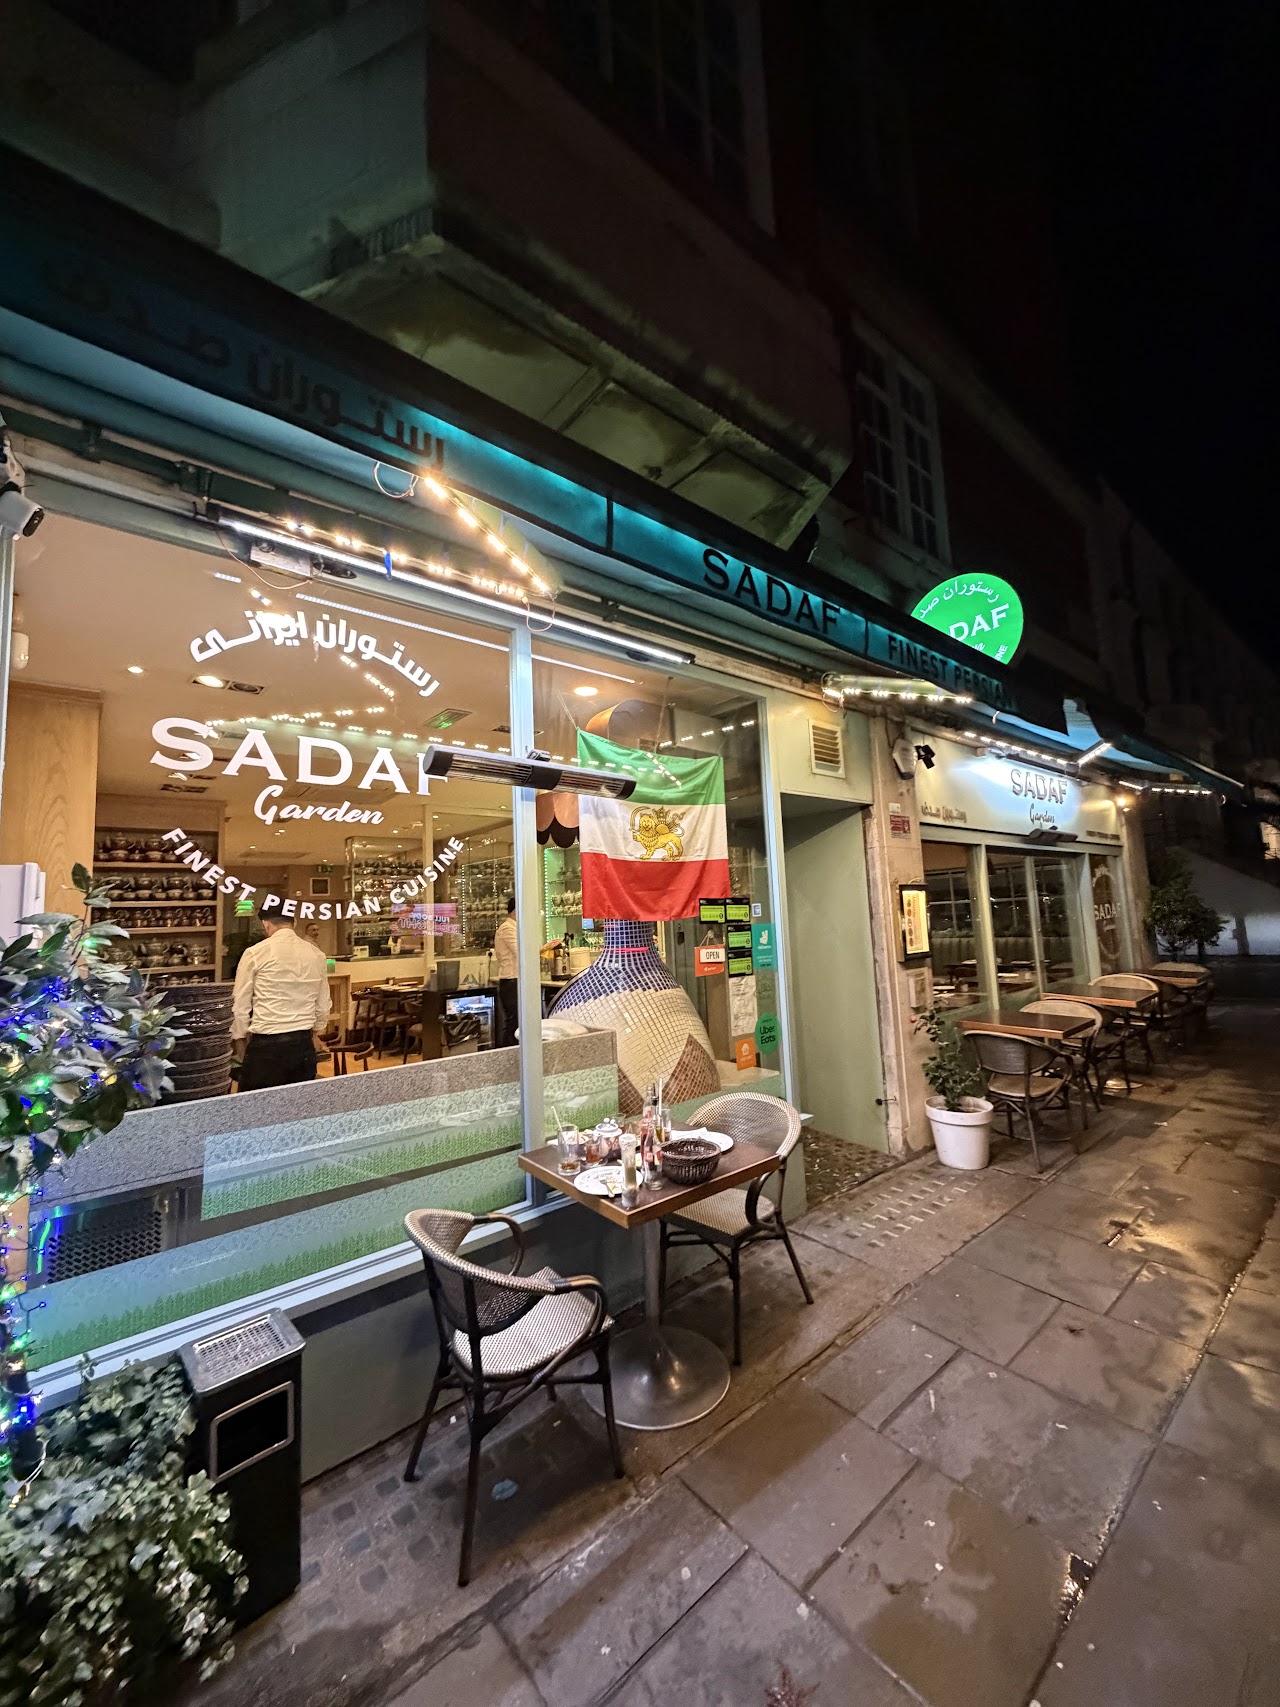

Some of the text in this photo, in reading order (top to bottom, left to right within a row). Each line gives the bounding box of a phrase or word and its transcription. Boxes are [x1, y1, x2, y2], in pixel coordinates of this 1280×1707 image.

[246, 343, 446, 472] رستوران
[702, 547, 841, 634] SADAF
[887, 634, 948, 681] FINEST
[919, 579, 1000, 620] رستوران صد
[949, 602, 1009, 642] DAF
[314, 613, 440, 697] رستوران
[150, 717, 448, 796] SADAF
[253, 784, 385, 825] Garden
[1010, 768, 1068, 804] SADAF
[1029, 803, 1055, 827] Garden
[161, 827, 465, 920] FINEST PERSIAN CUISINE
[705, 951, 720, 960] OPEN
[759, 1025, 775, 1035] Uber
[760, 1034, 776, 1045] Eats
